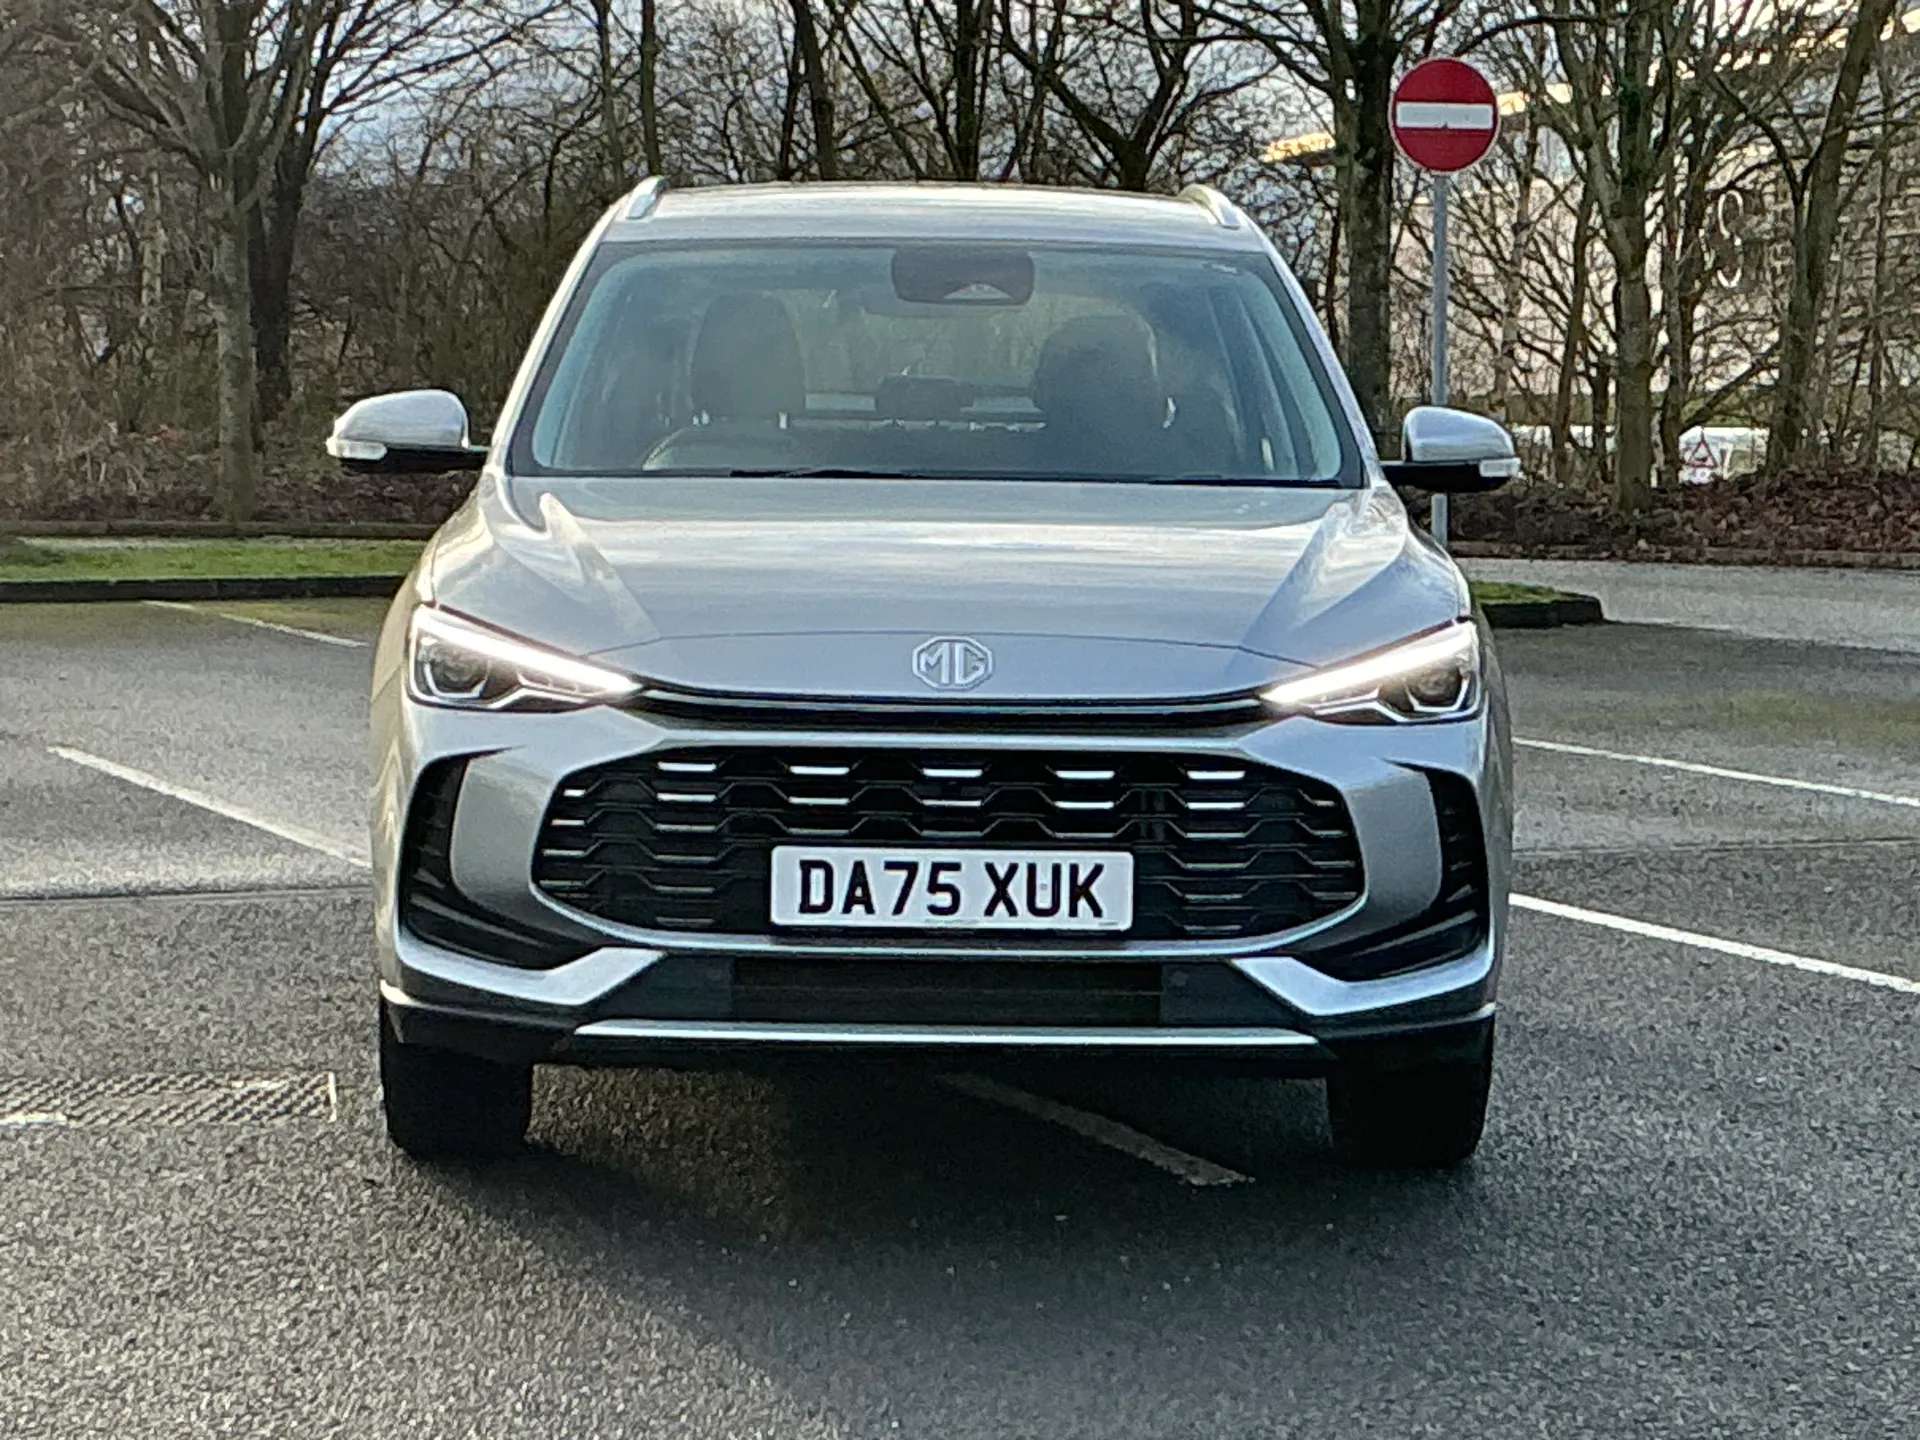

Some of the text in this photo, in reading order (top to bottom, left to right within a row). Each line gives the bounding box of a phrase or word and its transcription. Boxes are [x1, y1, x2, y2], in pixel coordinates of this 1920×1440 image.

[919, 641, 986, 684] MG
[798, 859, 1105, 918] DA75 XUK
